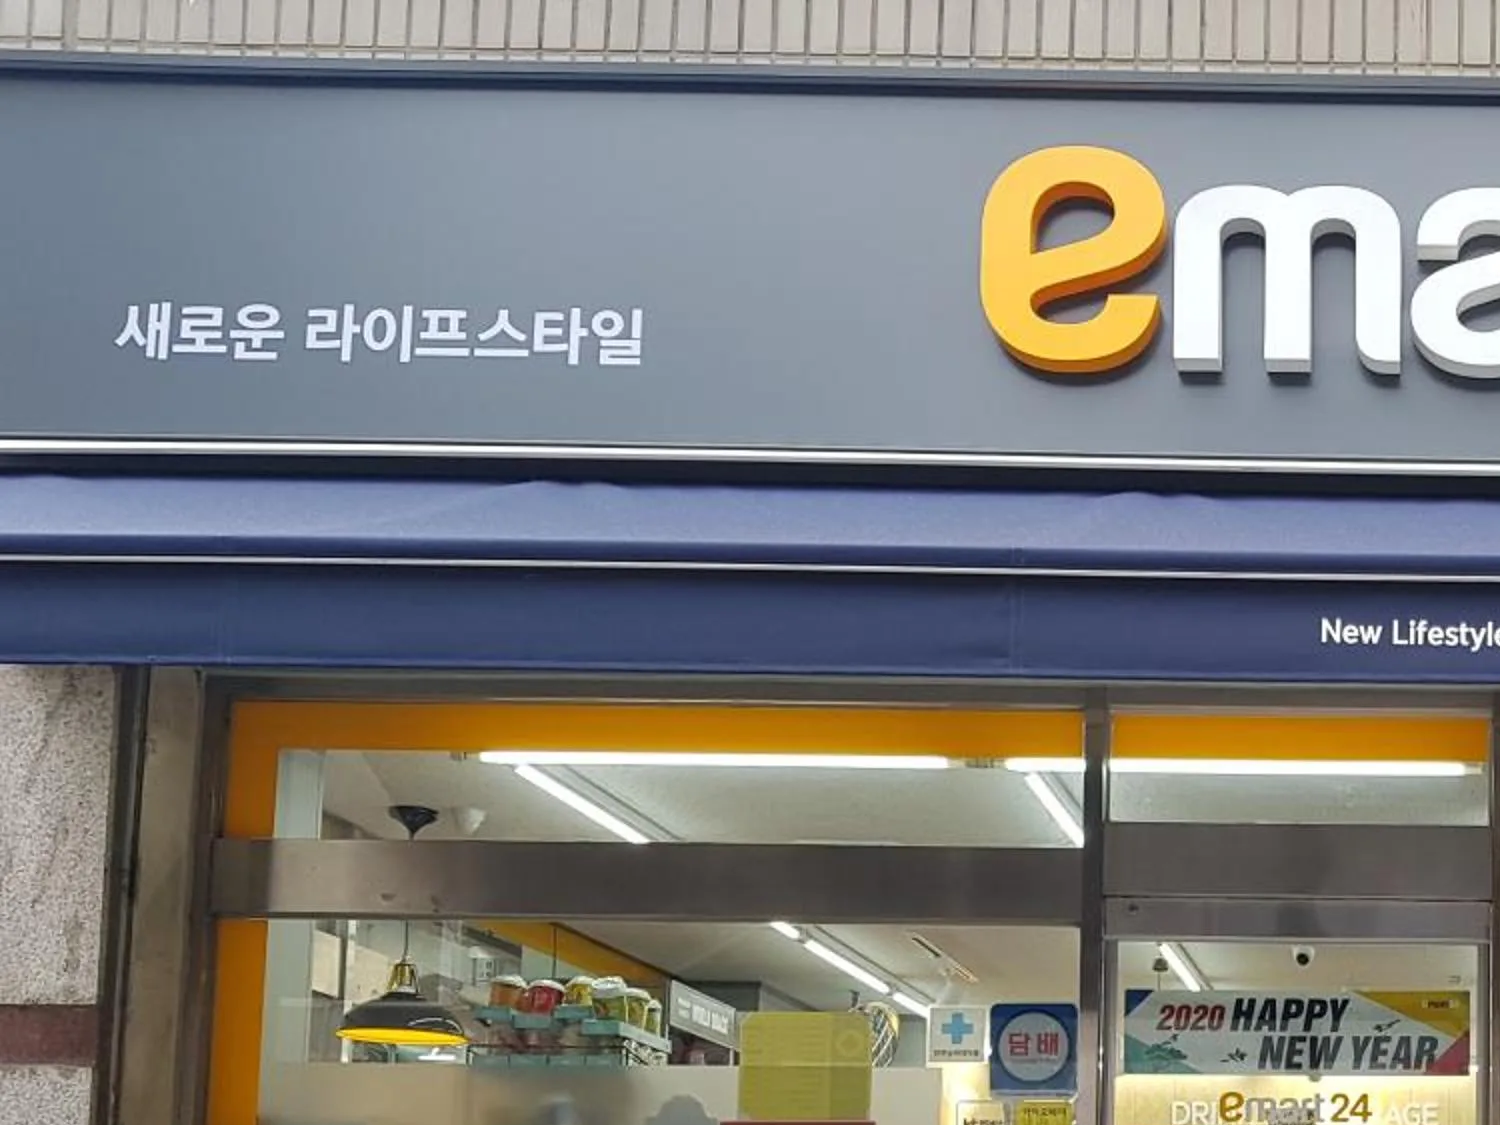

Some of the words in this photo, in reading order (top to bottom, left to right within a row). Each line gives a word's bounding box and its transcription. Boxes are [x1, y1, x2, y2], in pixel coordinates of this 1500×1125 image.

[115, 302, 284, 361] 새로운
[305, 304, 645, 366] 라이프스타일
[1320, 617, 1383, 646] New
[1155, 1004, 1227, 1032] 2020
[1229, 997, 1351, 1033] HAPPY
[1257, 1035, 1345, 1072] NEW
[1350, 1035, 1440, 1072] YEAR
[1218, 1090, 1373, 1123] emart24
